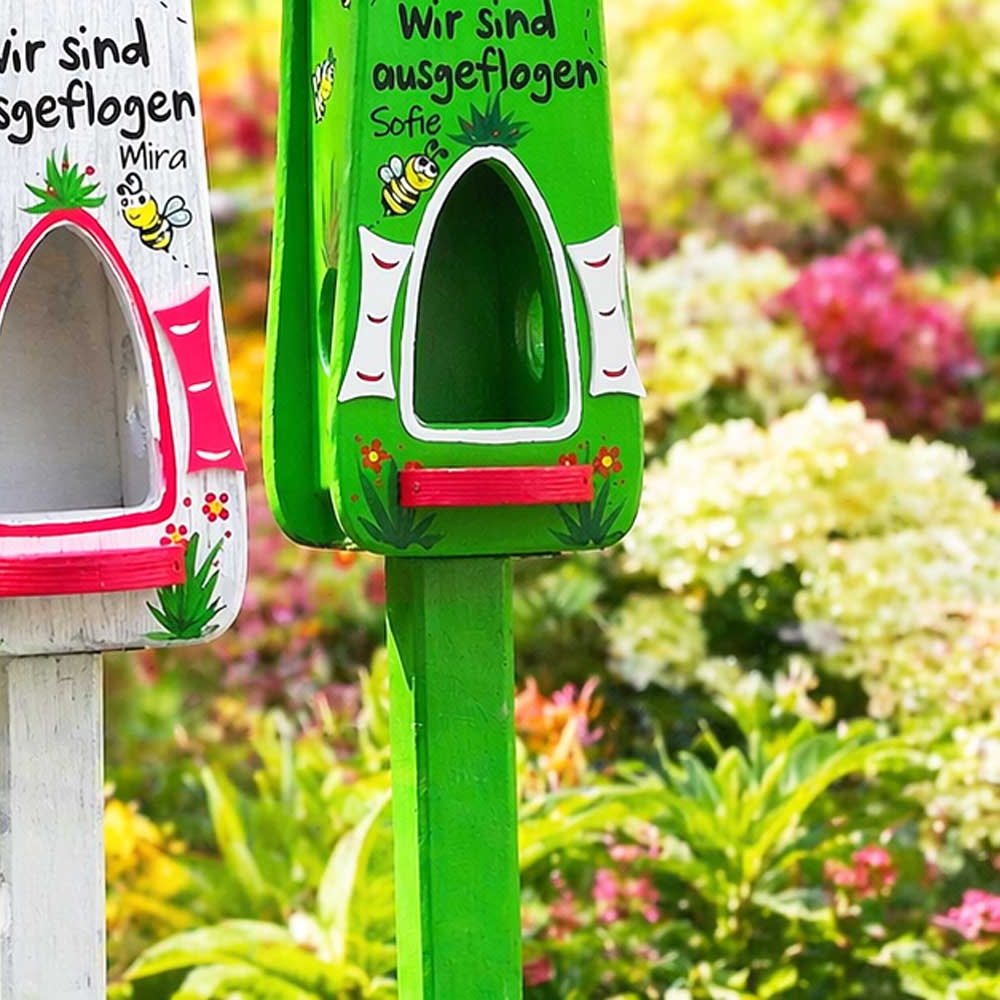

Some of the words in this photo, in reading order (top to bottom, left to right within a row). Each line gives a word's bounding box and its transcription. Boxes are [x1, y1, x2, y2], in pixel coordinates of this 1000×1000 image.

[59, 18, 150, 70] sind
[372, 46, 597, 104] ausgeflogen
[370, 105, 442, 138] Sofie
[119, 141, 187, 170] Mira
